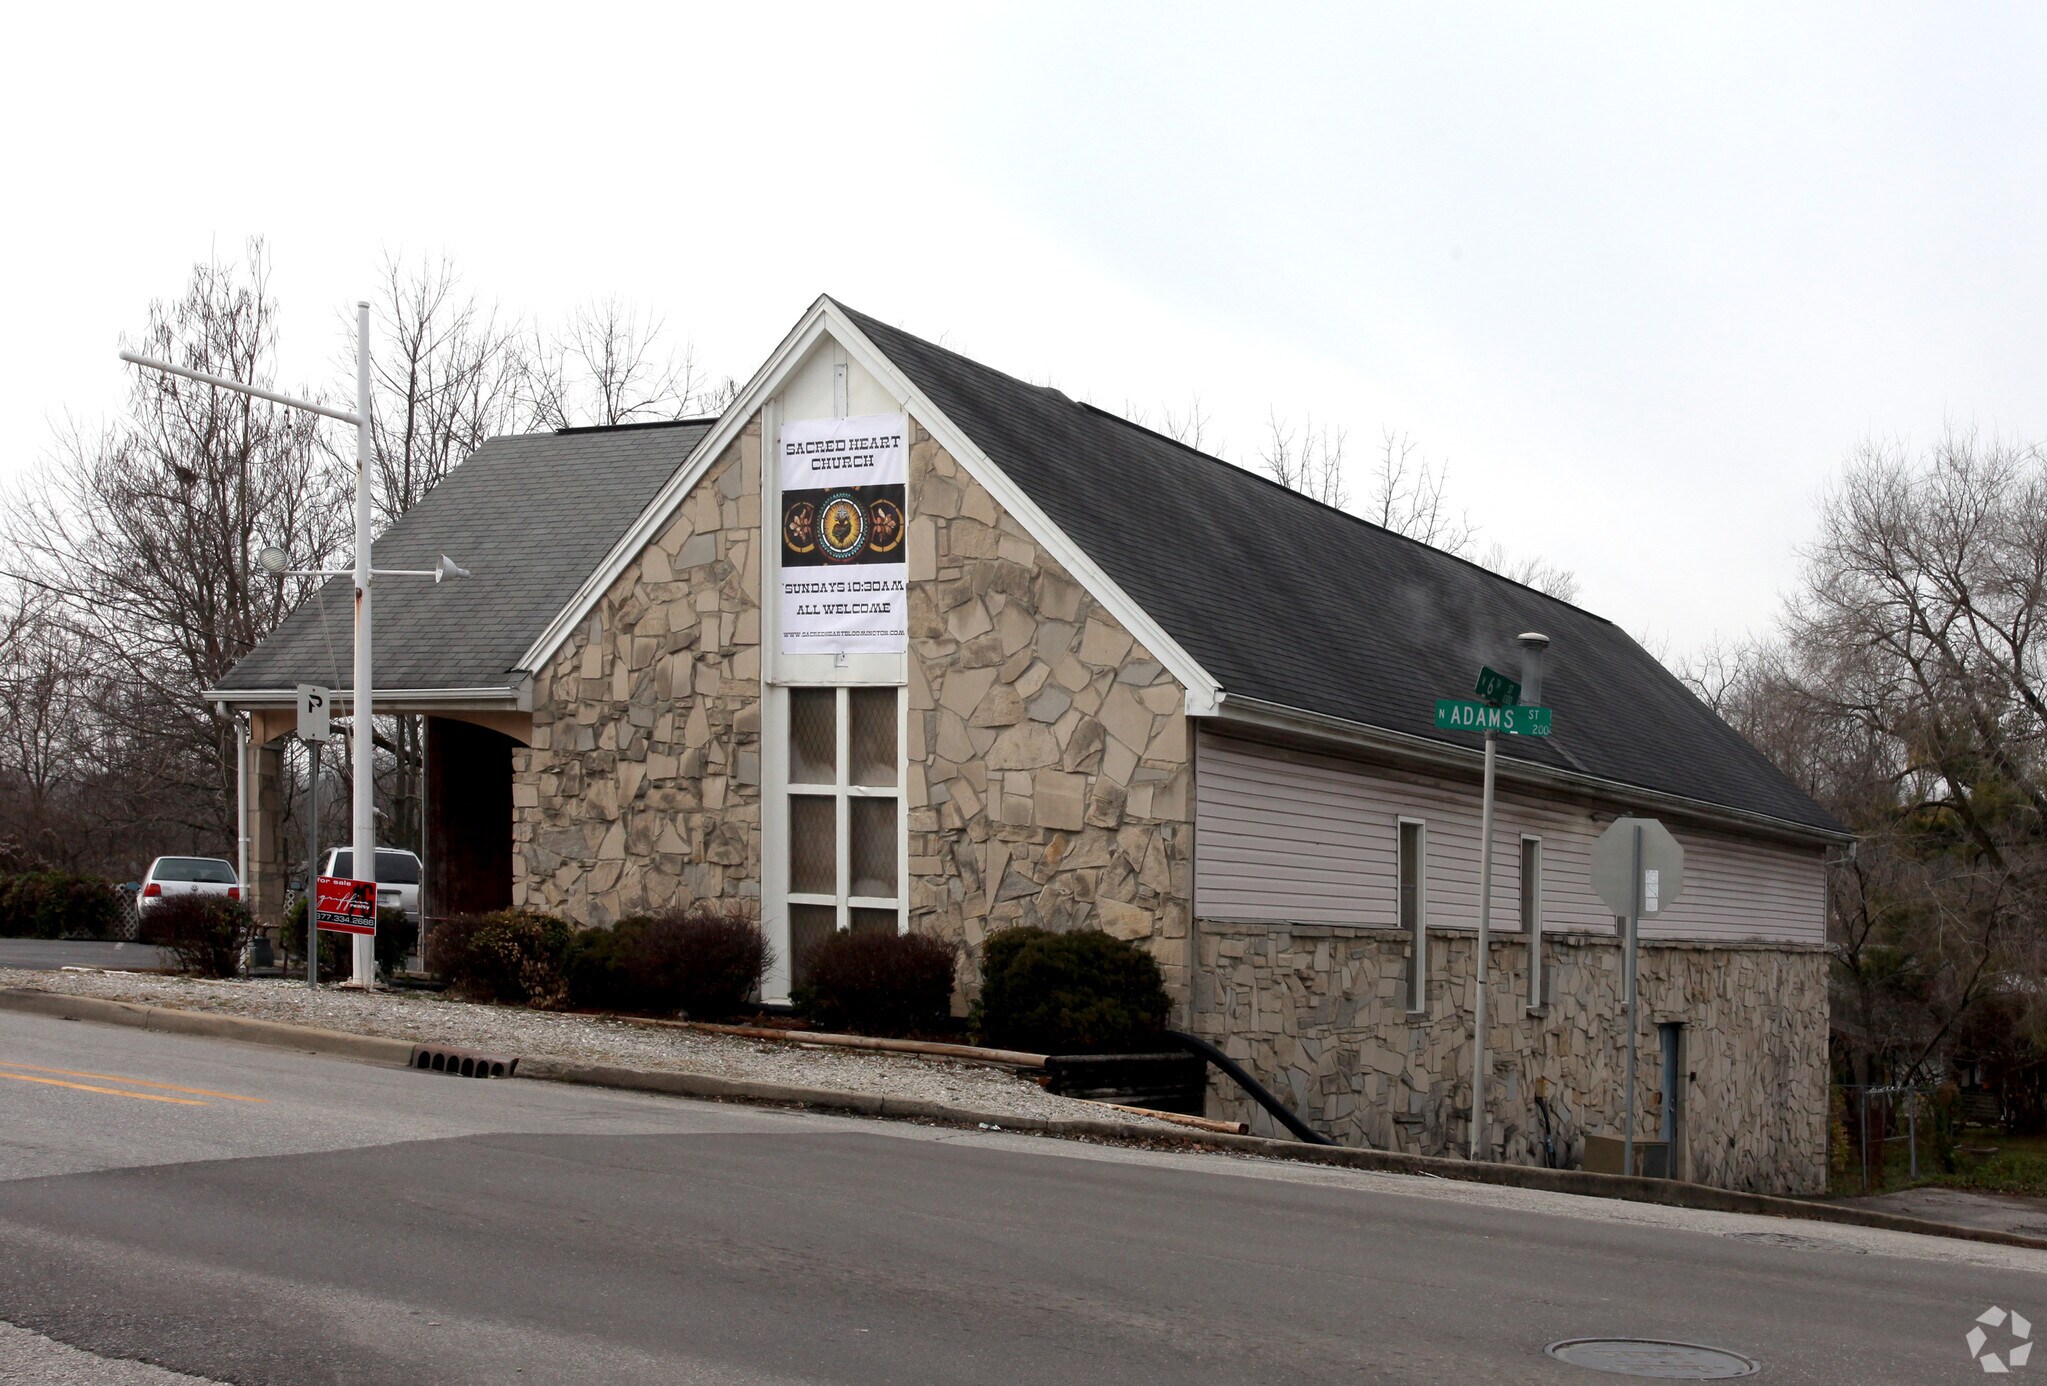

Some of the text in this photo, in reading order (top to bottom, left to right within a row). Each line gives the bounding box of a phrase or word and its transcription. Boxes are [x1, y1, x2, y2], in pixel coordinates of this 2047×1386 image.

[786, 435, 901, 456] SACRED HEART
[811, 454, 874, 470] CHURCH
[785, 582, 845, 594] SUNDAYS
[796, 602, 891, 615] ALL WELCOME
[1439, 705, 1540, 729] N ADAMS ST
[1532, 724, 1550, 735] 200
[349, 903, 371, 911] realty
